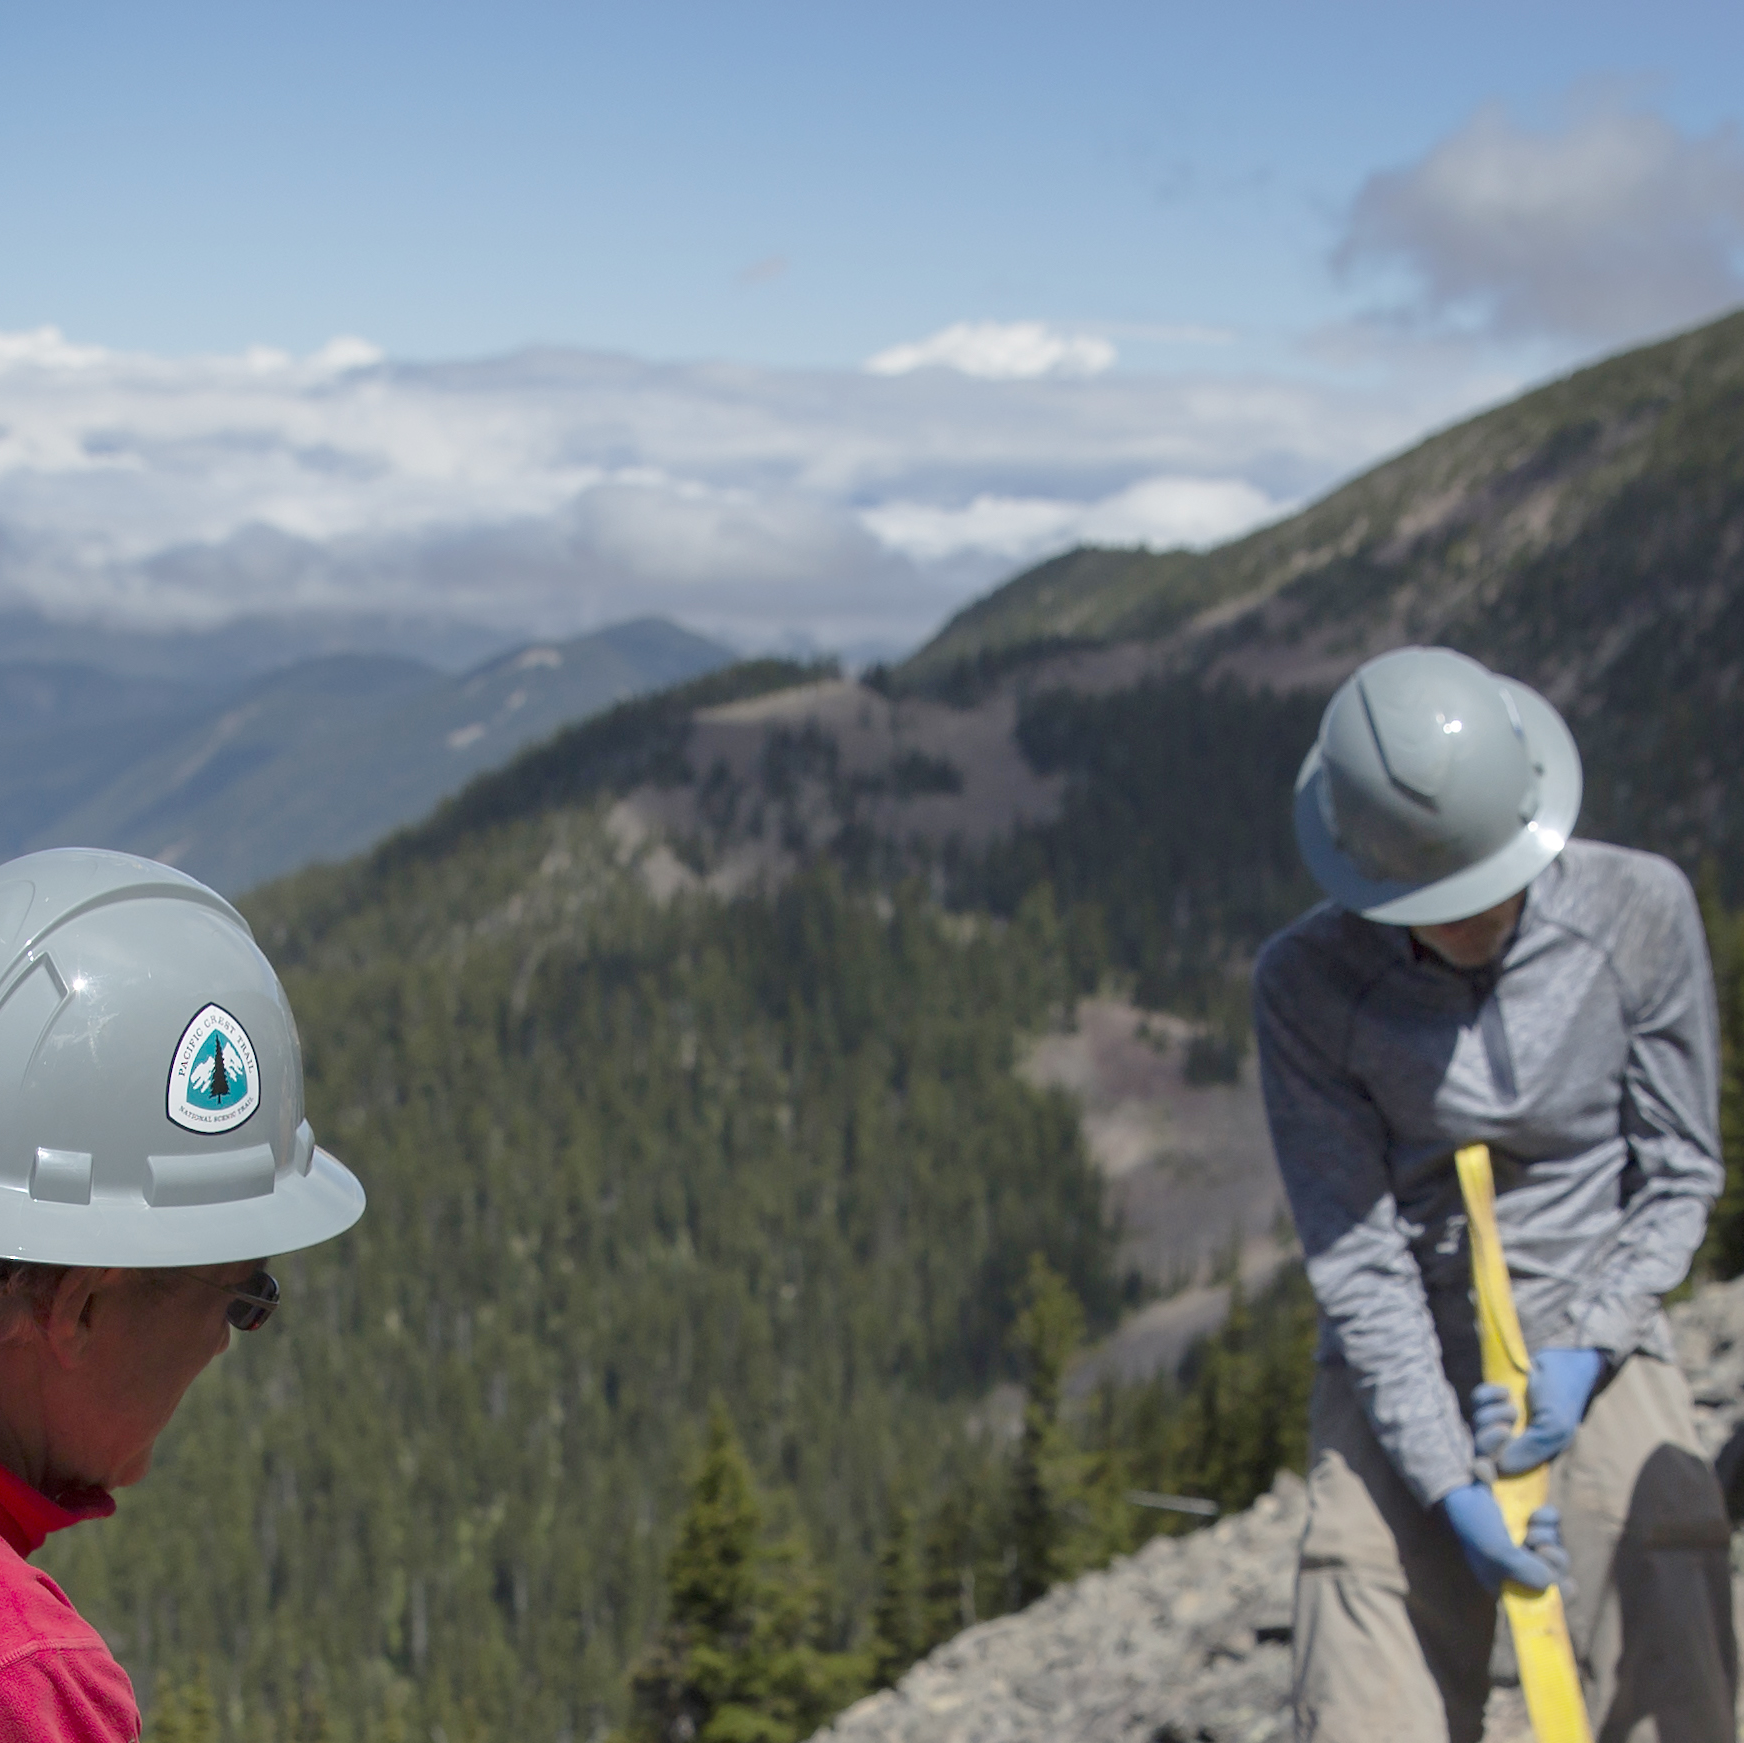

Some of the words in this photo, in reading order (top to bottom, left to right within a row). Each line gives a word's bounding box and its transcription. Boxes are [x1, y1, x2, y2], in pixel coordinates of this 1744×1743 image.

[178, 1027, 203, 1077] PACIFIC
[203, 1015, 236, 1034] CREST
[236, 1035, 255, 1074] TRAIL
[178, 1105, 213, 1123] NATIONAL
[237, 1096, 255, 1115] TRAIL
